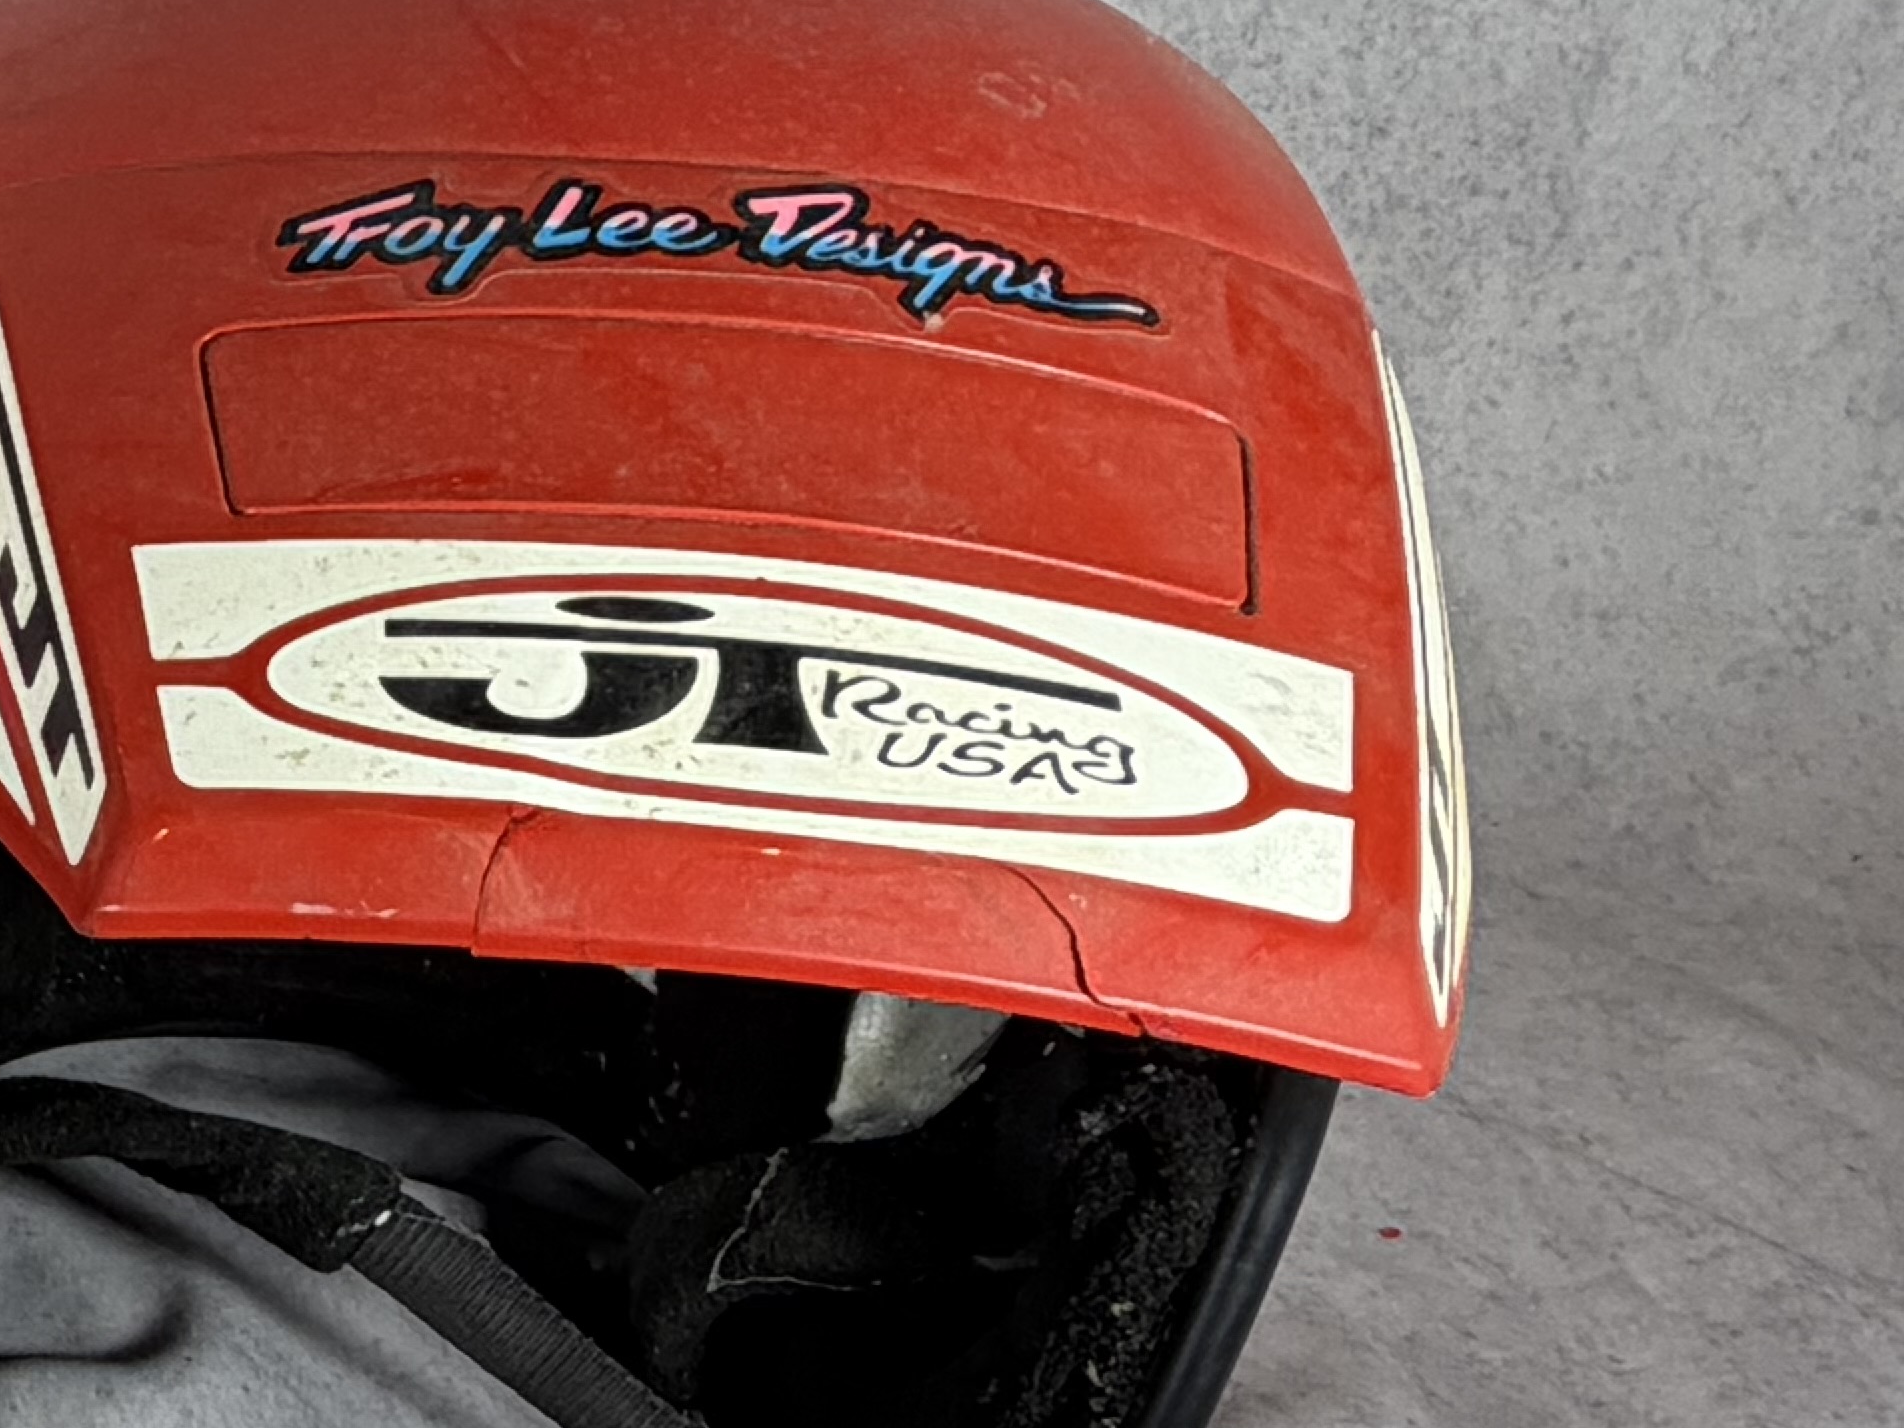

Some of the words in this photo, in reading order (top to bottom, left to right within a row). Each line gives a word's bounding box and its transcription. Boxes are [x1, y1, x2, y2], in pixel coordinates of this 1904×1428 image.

[290, 186, 510, 289] Troy
[526, 183, 724, 255] Lee
[742, 189, 1154, 322] Designs
[823, 669, 1138, 786] Racing
